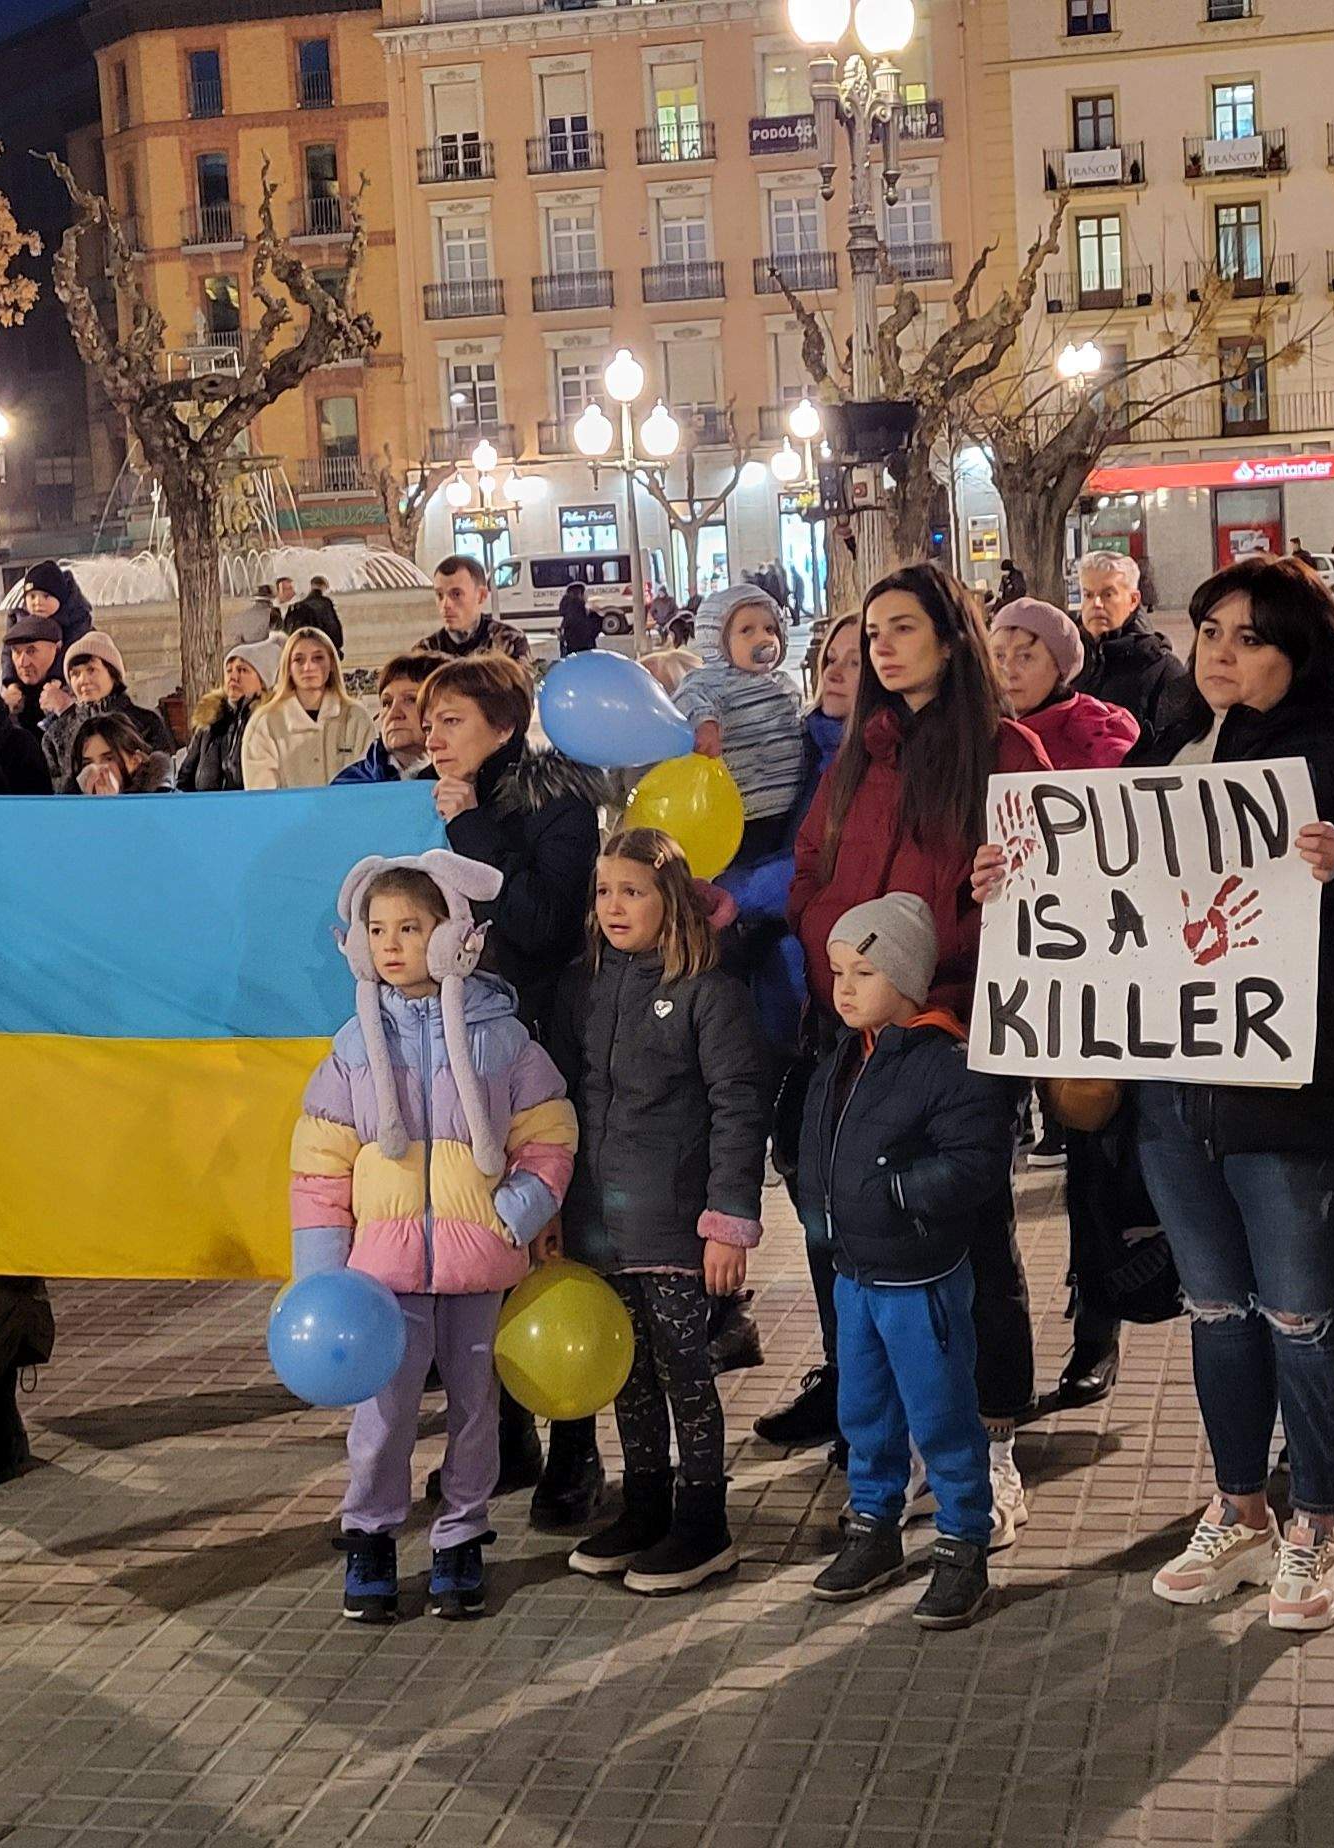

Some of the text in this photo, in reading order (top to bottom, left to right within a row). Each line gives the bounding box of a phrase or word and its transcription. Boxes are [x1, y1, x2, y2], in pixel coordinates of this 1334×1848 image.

[1254, 460, 1333, 480] Santander
[1031, 768, 1289, 877] PUTIN
[1017, 889, 1149, 960] IS A
[988, 976, 1293, 1062] KILLER
